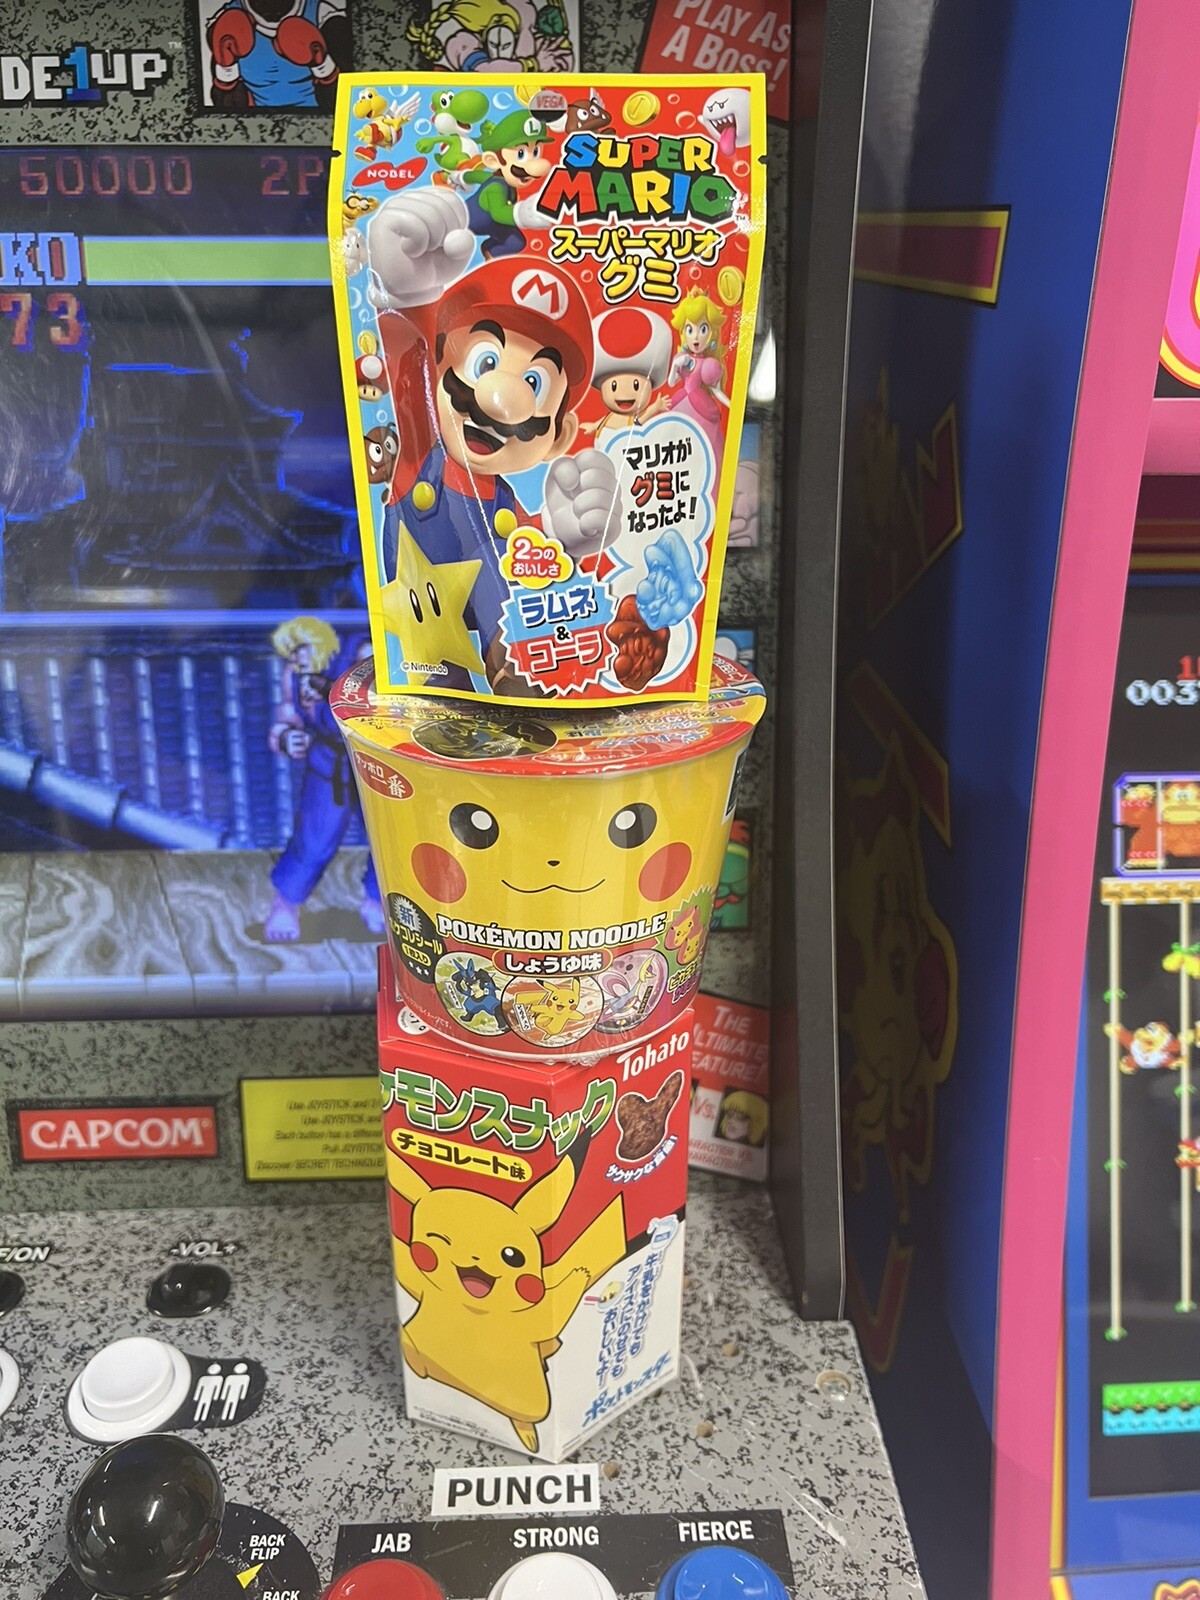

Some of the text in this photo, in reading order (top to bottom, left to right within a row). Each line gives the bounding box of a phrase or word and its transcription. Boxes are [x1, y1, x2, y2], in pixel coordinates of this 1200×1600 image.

[661, 25, 691, 62] A
[673, 0, 791, 53] PLAY AS
[535, 94, 564, 108] VEGA
[565, 133, 714, 172] SUPER
[19, 155, 324, 196] 50000 2P
[367, 168, 415, 179] NOBEL
[538, 169, 736, 218] MARIO
[551, 227, 721, 262] スーパーマリオ
[601, 254, 679, 299] グミ
[0, 292, 84, 346] 73
[623, 437, 693, 471] マリオが
[630, 470, 691, 508] グミに
[512, 560, 561, 578] おいしさ
[520, 586, 599, 624] ラムネ
[556, 625, 571, 641] &
[527, 631, 603, 674] コーラ
[1177, 655, 1200, 680] 1
[1126, 679, 1200, 706] 003
[399, 904, 416, 927] 新
[437, 911, 667, 950] POKÉMON NOODLE
[505, 952, 603, 975] しょうゆ味
[714, 1005, 751, 1034] THE
[616, 1032, 690, 1081] Tohato
[397, 1132, 526, 1181] チョコレート味
[447, 1473, 593, 1507] PUNCH
[249, 1534, 287, 1547] BACK
[371, 1532, 412, 1554] JAB
[513, 1525, 600, 1549] STRONG
[679, 1519, 755, 1542] FIERCE
[250, 1547, 280, 1560] FLIP
